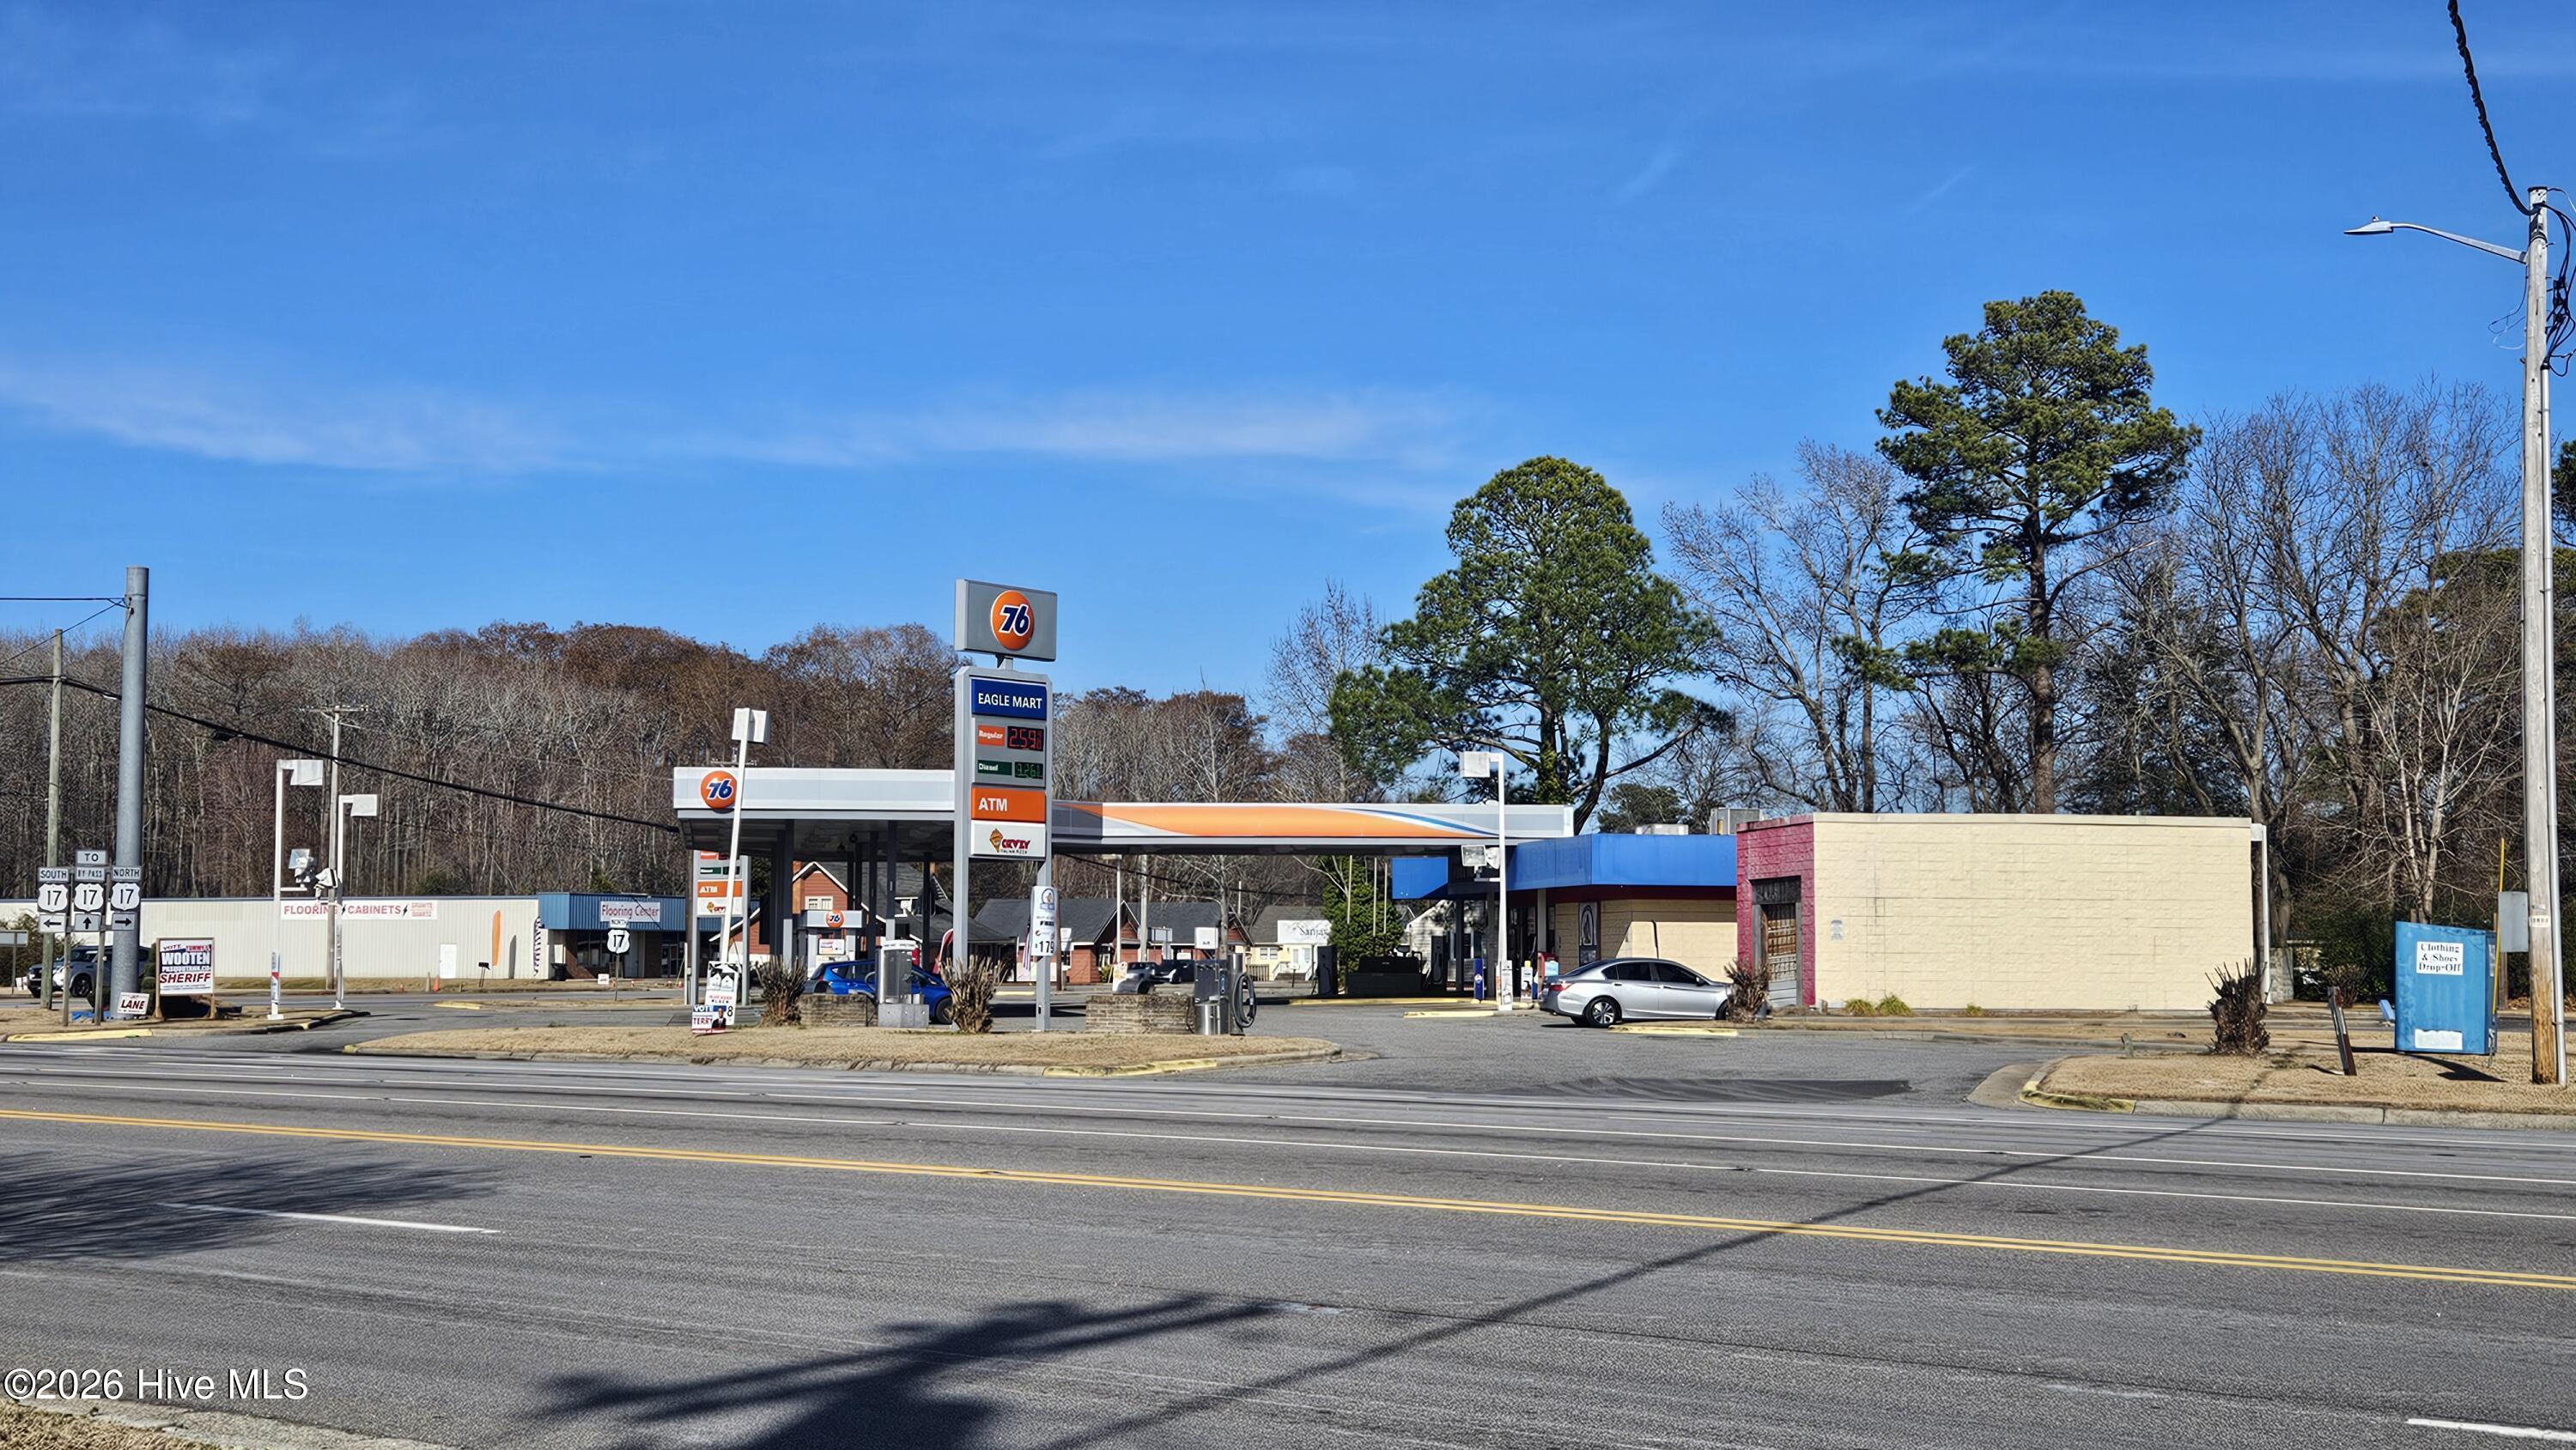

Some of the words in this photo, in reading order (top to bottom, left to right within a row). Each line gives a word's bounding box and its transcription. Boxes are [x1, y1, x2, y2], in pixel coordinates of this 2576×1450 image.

[999, 604, 1030, 637] 76
[978, 693, 1010, 707] EAGLE
[1012, 696, 1042, 709] MART
[978, 730, 1003, 739] Regular
[978, 763, 999, 772] Diesel
[707, 779, 734, 799] 76
[978, 797, 1008, 811] ATM
[84, 853, 99, 862] TO
[40, 870, 67, 879] SOUTH
[113, 868, 140, 877] NORTH
[47, 890, 62, 906] 17
[83, 889, 98, 905] 17
[120, 889, 134, 904] 17
[347, 906, 401, 914] CABINETS
[602, 905, 633, 919] Flooring
[614, 934, 625, 948] 17
[2421, 943, 2459, 953] Clothing
[161, 952, 210, 965] WOOTEN
[2419, 962, 2461, 973] Drop-Off
[159, 973, 210, 983] SHERIFF
[120, 999, 145, 1010] LANE
[726, 1005, 734, 1017] 8
